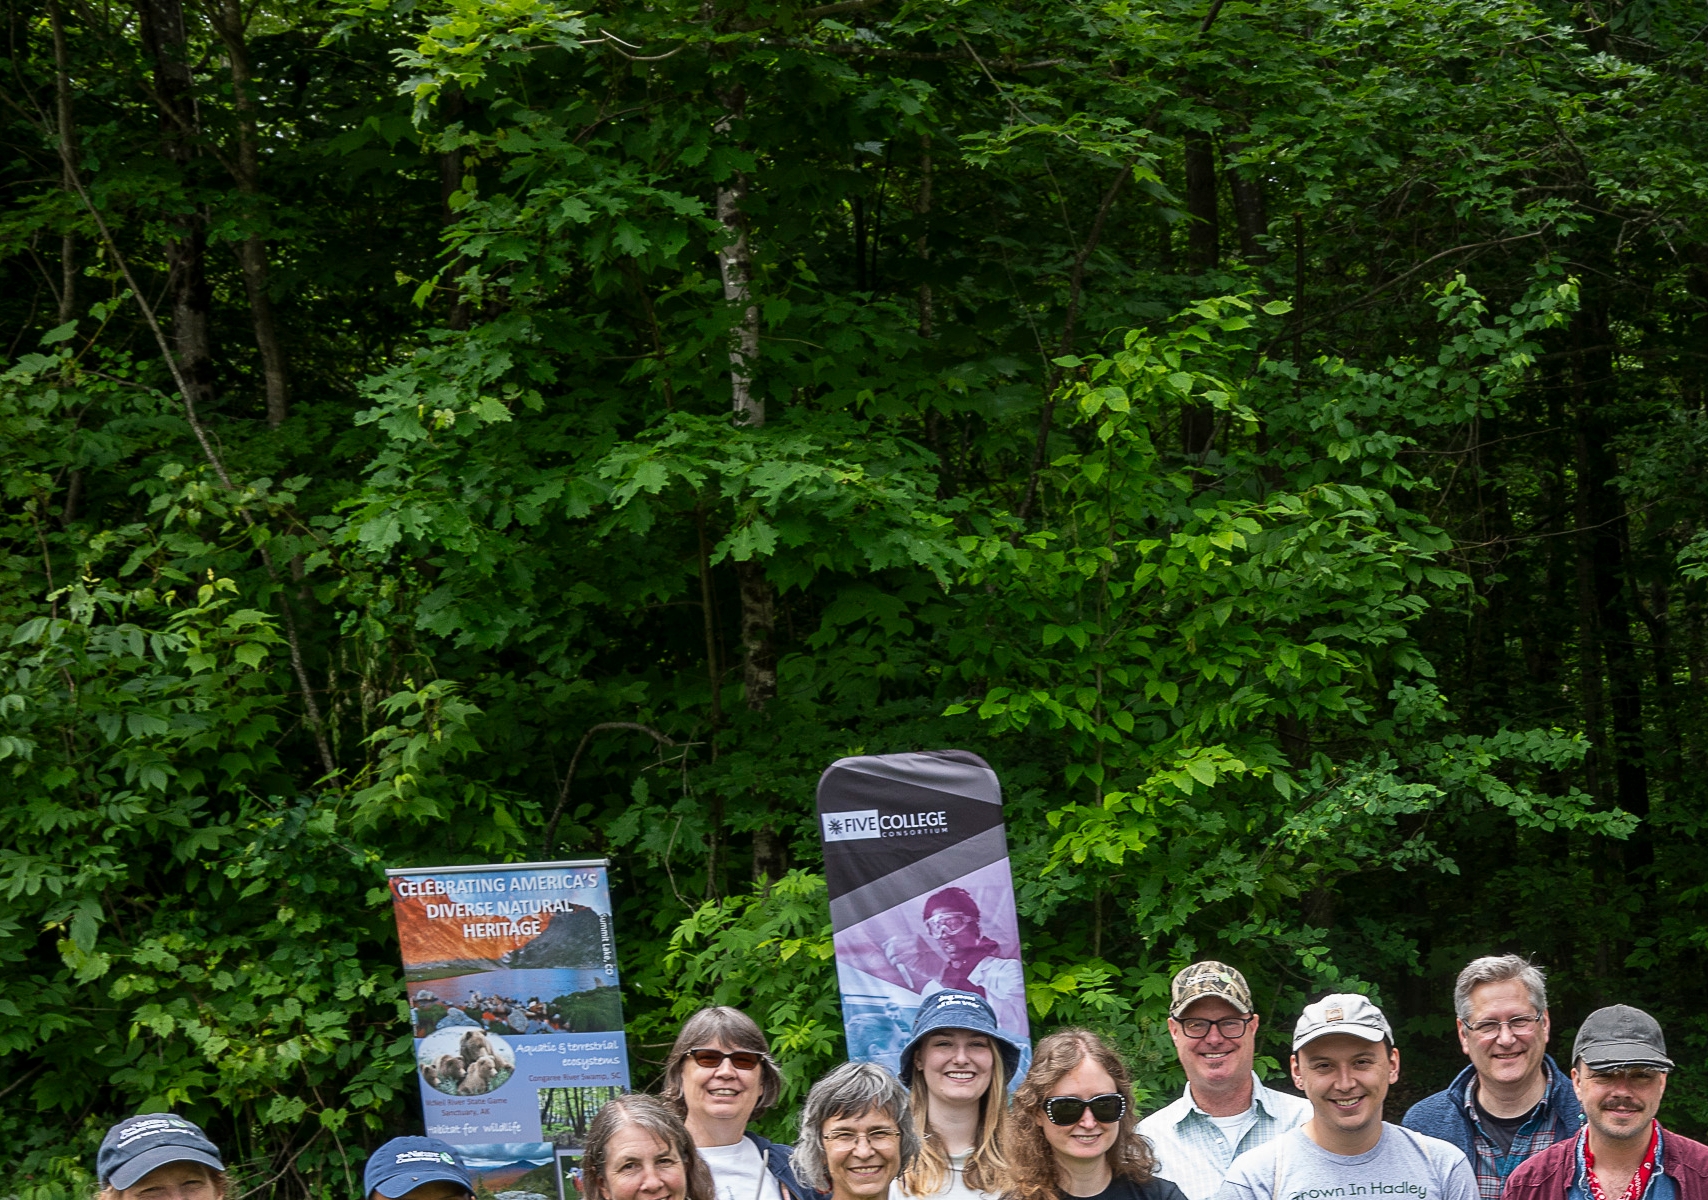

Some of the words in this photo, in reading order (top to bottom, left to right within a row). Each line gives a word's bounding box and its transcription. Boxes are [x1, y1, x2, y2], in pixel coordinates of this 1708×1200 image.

[845, 817, 877, 833] FIVE
[880, 811, 948, 830] COLLEGE
[881, 827, 949, 838] CONSORTIUM
[397, 877, 506, 897] CELEBRATING
[510, 873, 599, 892] AMERICA'S
[426, 900, 495, 919] DIVERSE
[497, 898, 574, 915] NATURAL
[463, 920, 542, 939] HERITAGE
[599, 913, 611, 942] Summit
[604, 963, 614, 975] CO
[514, 1042, 557, 1056] Aquatic
[567, 1040, 619, 1053] terrestrial
[562, 1056, 621, 1070] ecosystems
[563, 1073, 580, 1081] River
[611, 1071, 621, 1079] SC
[487, 1097, 508, 1105] Game
[462, 1122, 479, 1136] for
[482, 1121, 522, 1134] wildlife
[1348, 1183, 1367, 1196] In
[1371, 1181, 1427, 1200] Hadley
